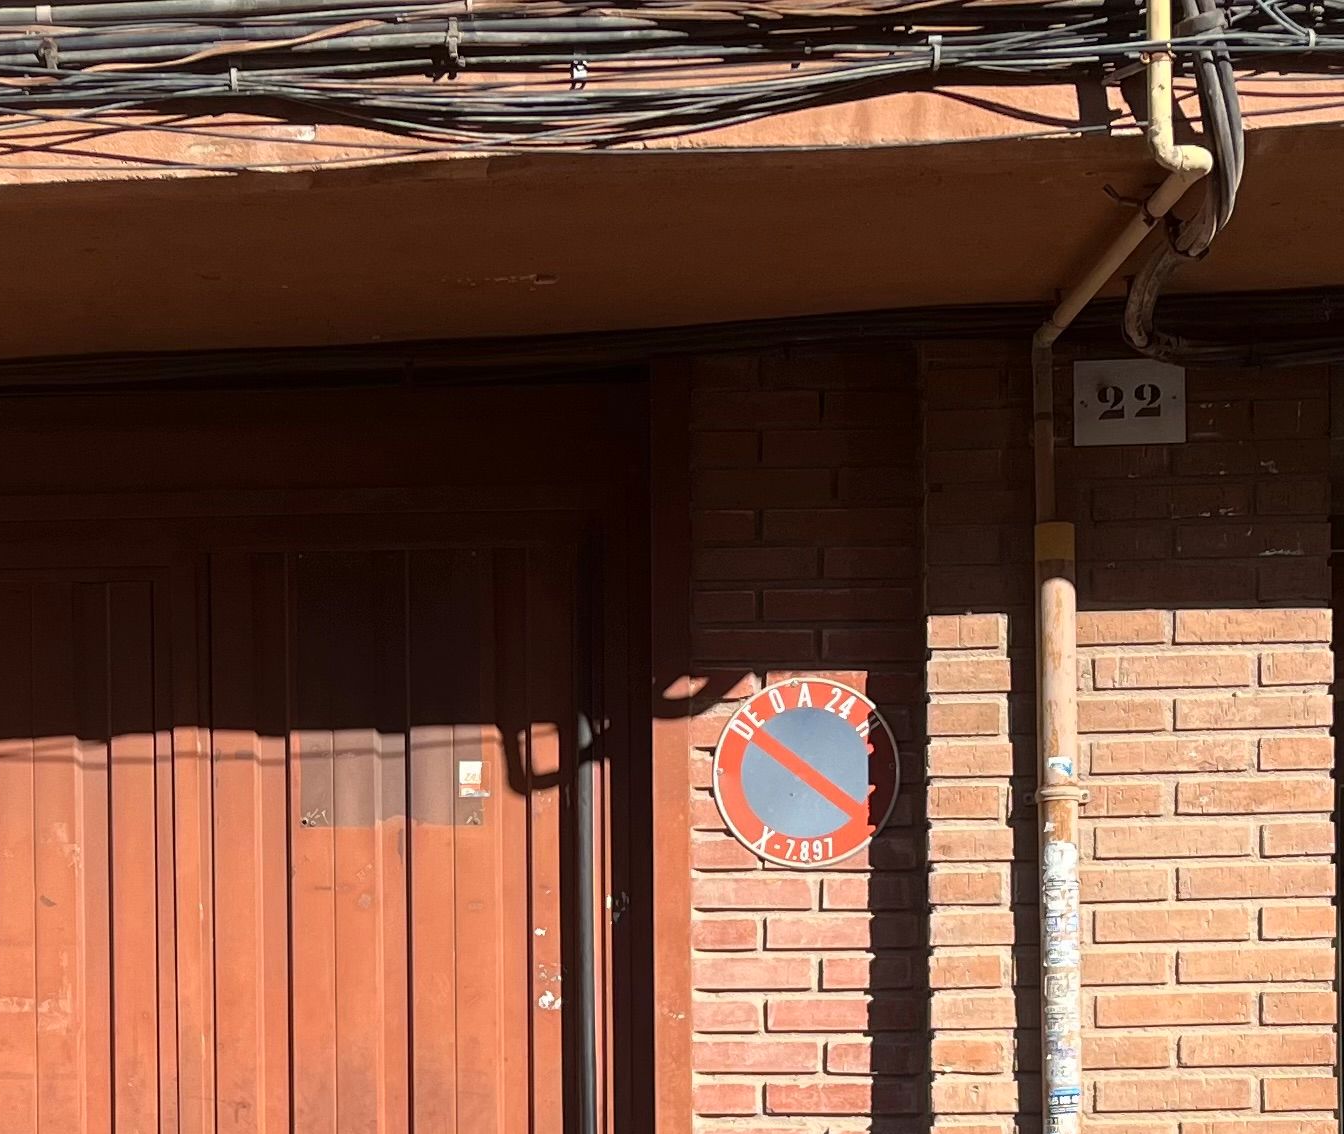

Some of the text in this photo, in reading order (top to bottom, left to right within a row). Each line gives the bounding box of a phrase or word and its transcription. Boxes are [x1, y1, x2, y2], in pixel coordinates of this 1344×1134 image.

[1097, 383, 1161, 420] 22
[729, 704, 766, 741] DE
[797, 682, 813, 708] A
[824, 687, 857, 720] 24
